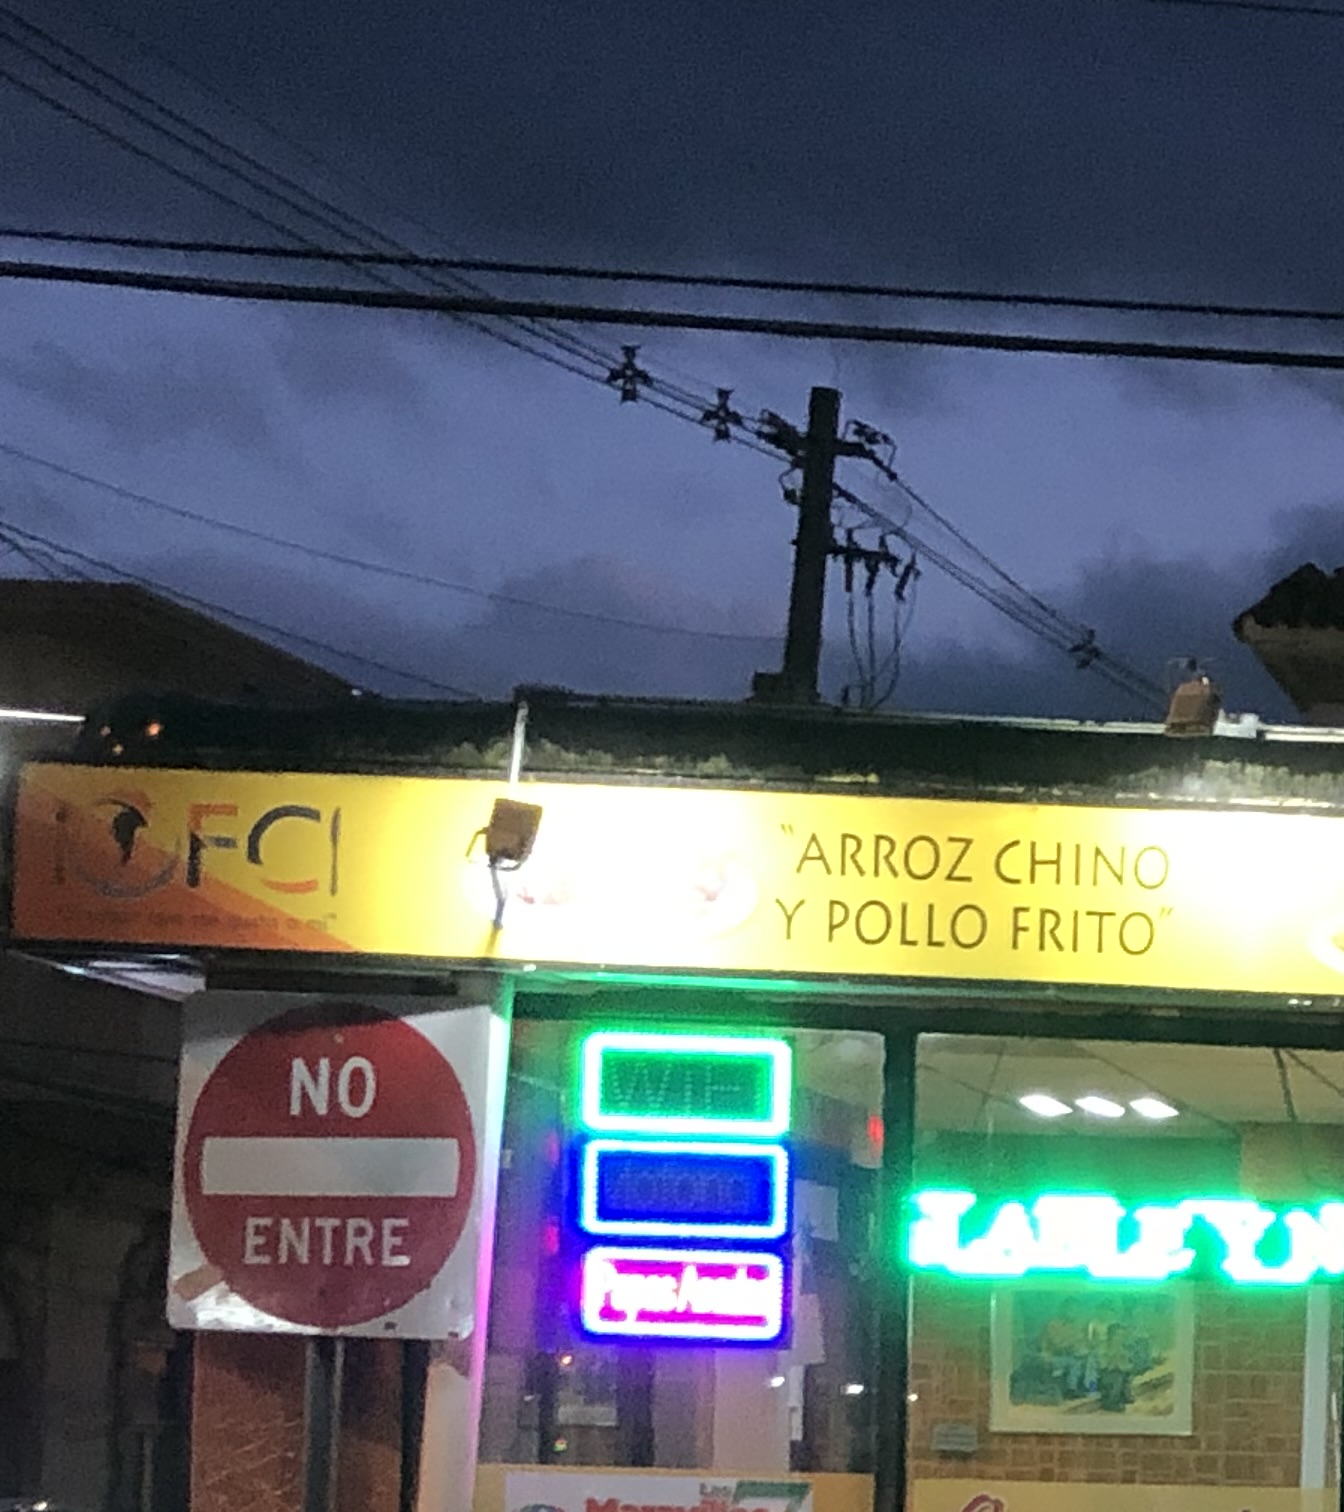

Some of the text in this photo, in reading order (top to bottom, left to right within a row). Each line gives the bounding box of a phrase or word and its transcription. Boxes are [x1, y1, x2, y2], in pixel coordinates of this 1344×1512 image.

[994, 838, 1170, 891] CHINO
[774, 898, 806, 941] Y
[827, 899, 989, 950] POLLO
[289, 1056, 377, 1119] NO
[242, 1215, 411, 1269] ENTRE
